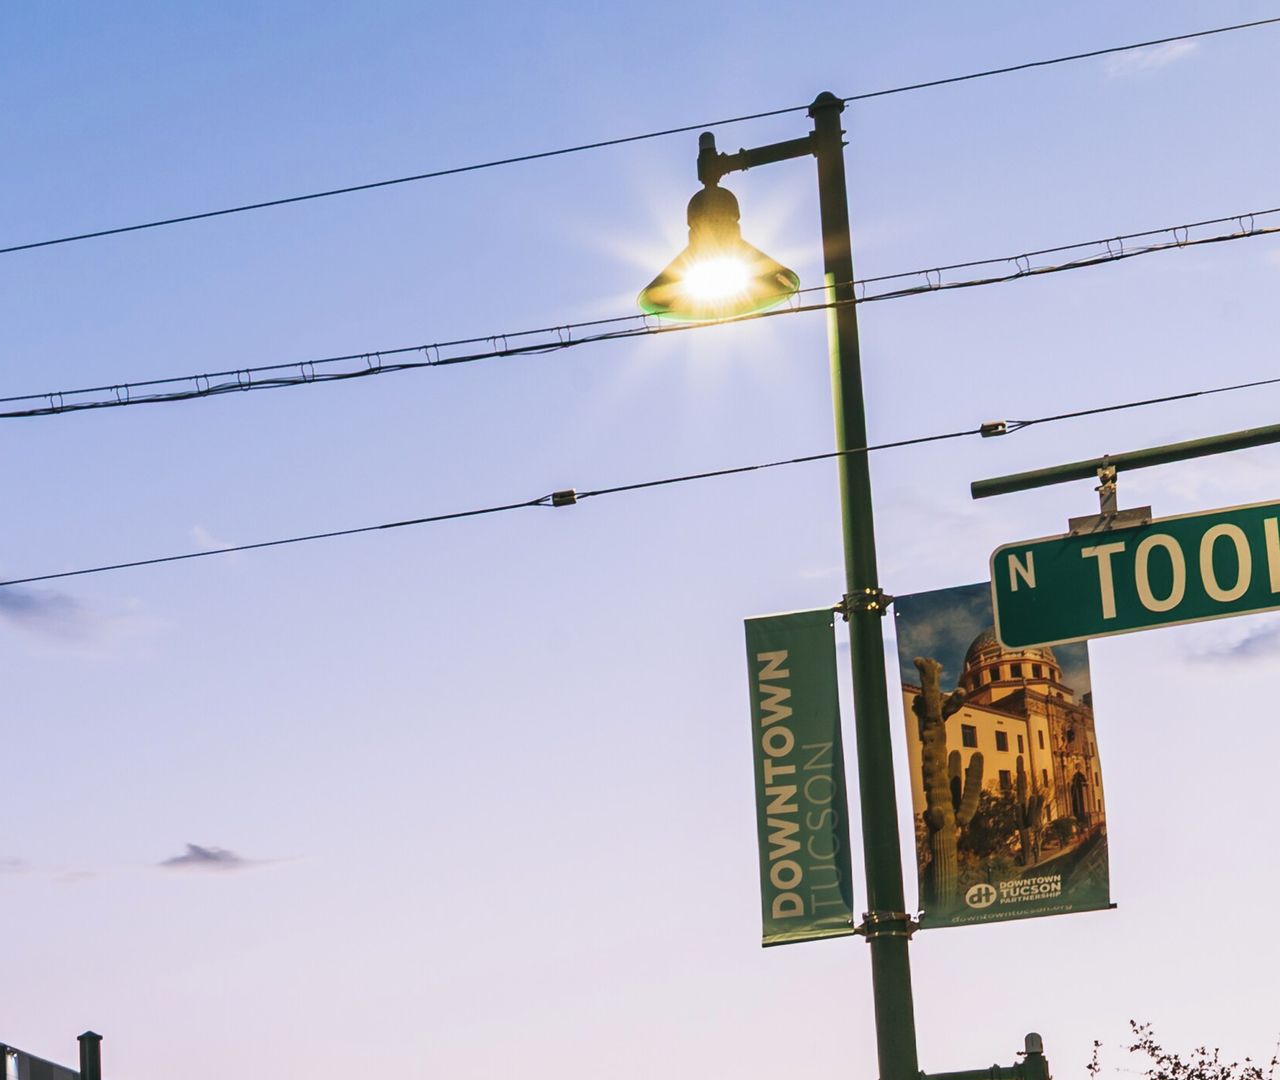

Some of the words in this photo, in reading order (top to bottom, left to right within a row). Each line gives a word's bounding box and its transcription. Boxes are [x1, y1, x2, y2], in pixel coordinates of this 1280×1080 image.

[1007, 551, 1037, 592] N
[757, 649, 804, 920] DOWNTOWN
[801, 741, 843, 915] TUCSON
[1000, 874, 1061, 889] DOWNTOWN
[1000, 882, 1061, 898] TUCSON
[1000, 891, 1061, 904] PARTNERSHIP
[952, 904, 1073, 923] downtowntucson.org
